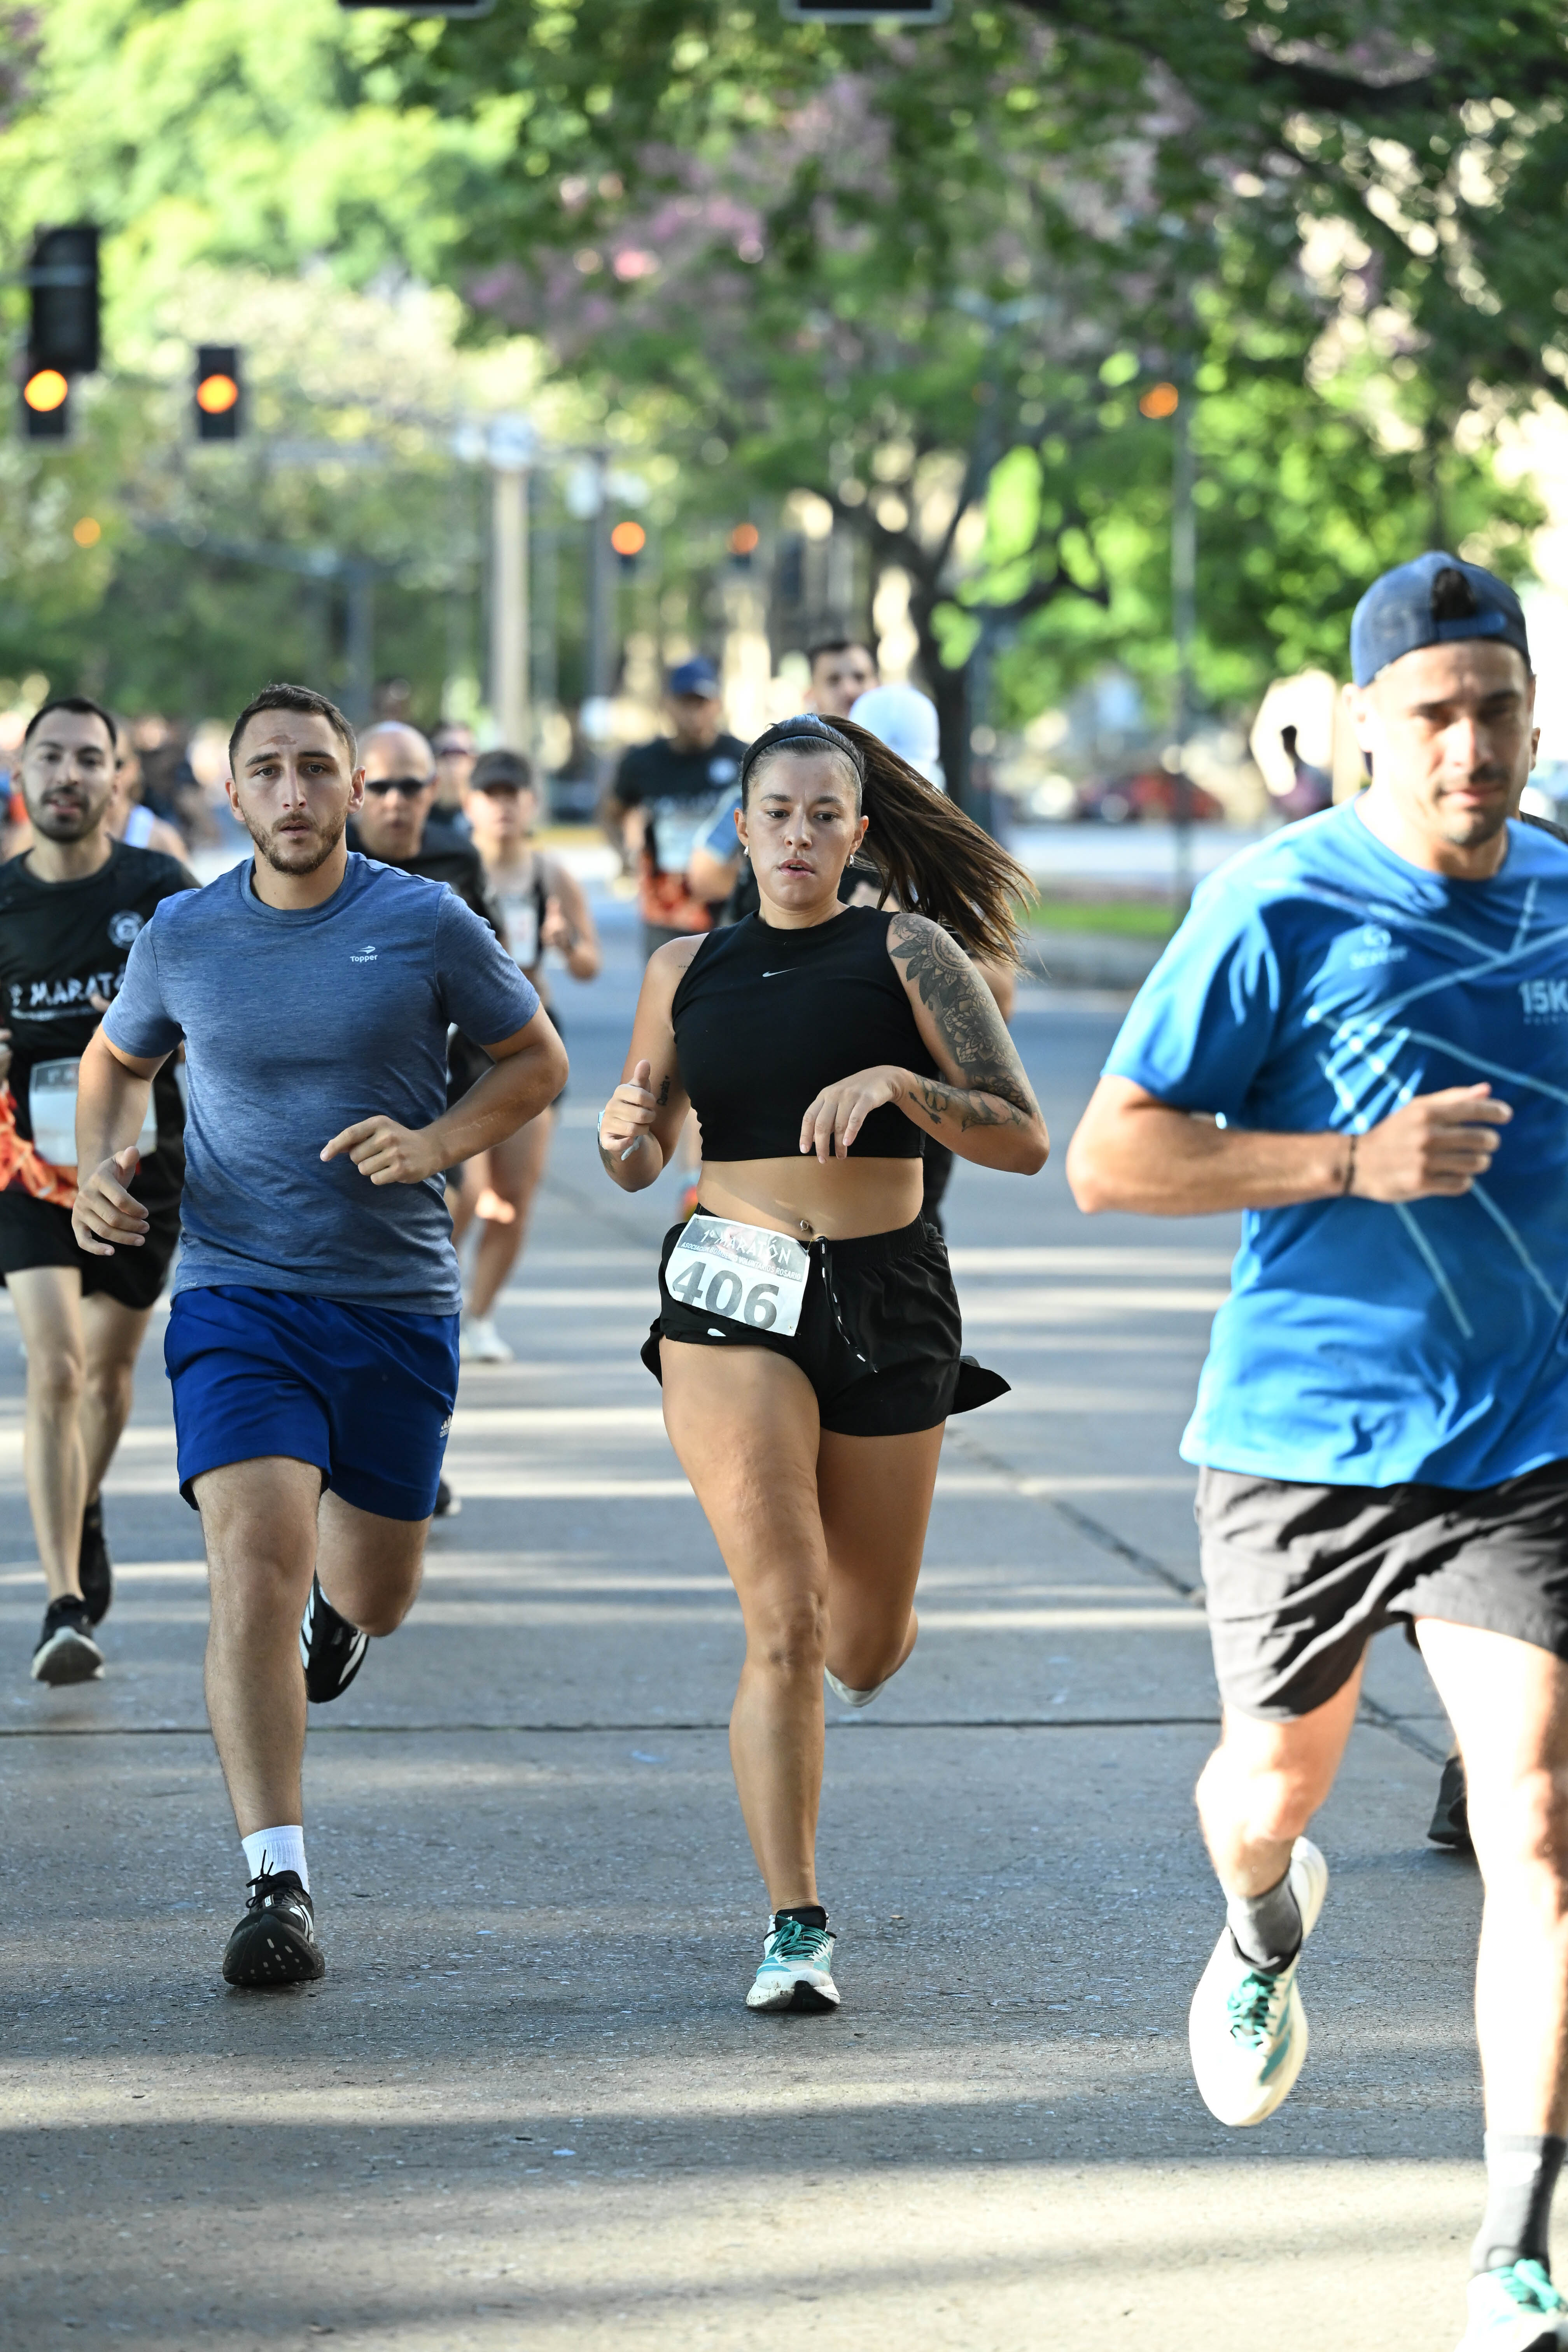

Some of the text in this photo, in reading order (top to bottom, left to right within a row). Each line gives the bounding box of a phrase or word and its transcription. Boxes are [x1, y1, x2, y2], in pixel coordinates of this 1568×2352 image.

[350, 955, 378, 963] Topper
[30, 963, 126, 1006] MARAT
[709, 1247, 738, 1262] BOMBEROS
[738, 1256, 775, 1273] VOLUNTARIOS
[775, 1267, 801, 1281] ROSARIO
[714, 1231, 791, 1266] MARATÓN
[672, 1261, 780, 1330] 406
